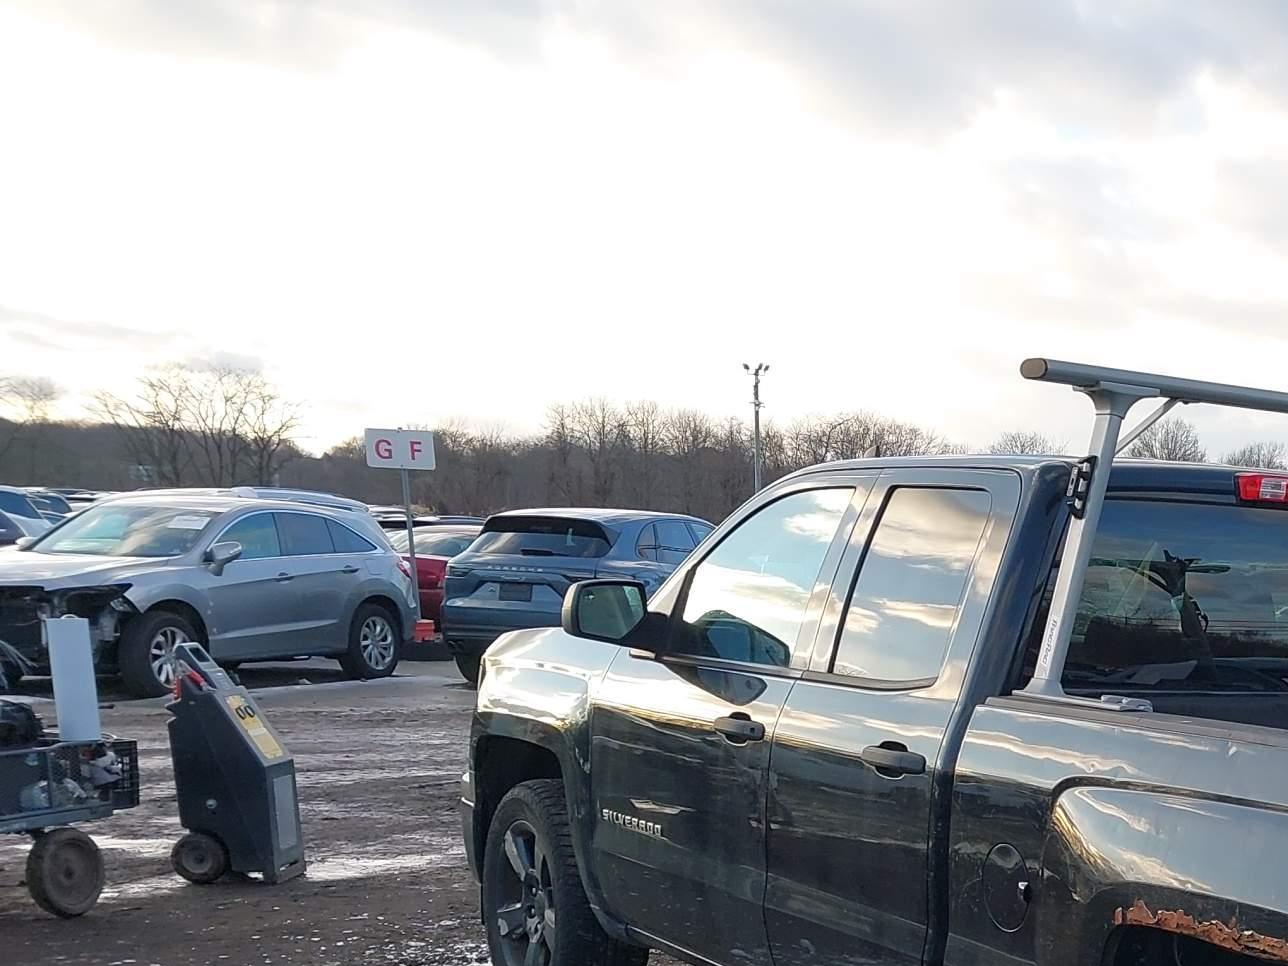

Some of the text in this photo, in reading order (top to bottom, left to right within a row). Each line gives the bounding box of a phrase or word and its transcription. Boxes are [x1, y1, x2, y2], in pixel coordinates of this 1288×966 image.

[374, 438, 423, 461] G F
[602, 808, 662, 837] SILVERADO
